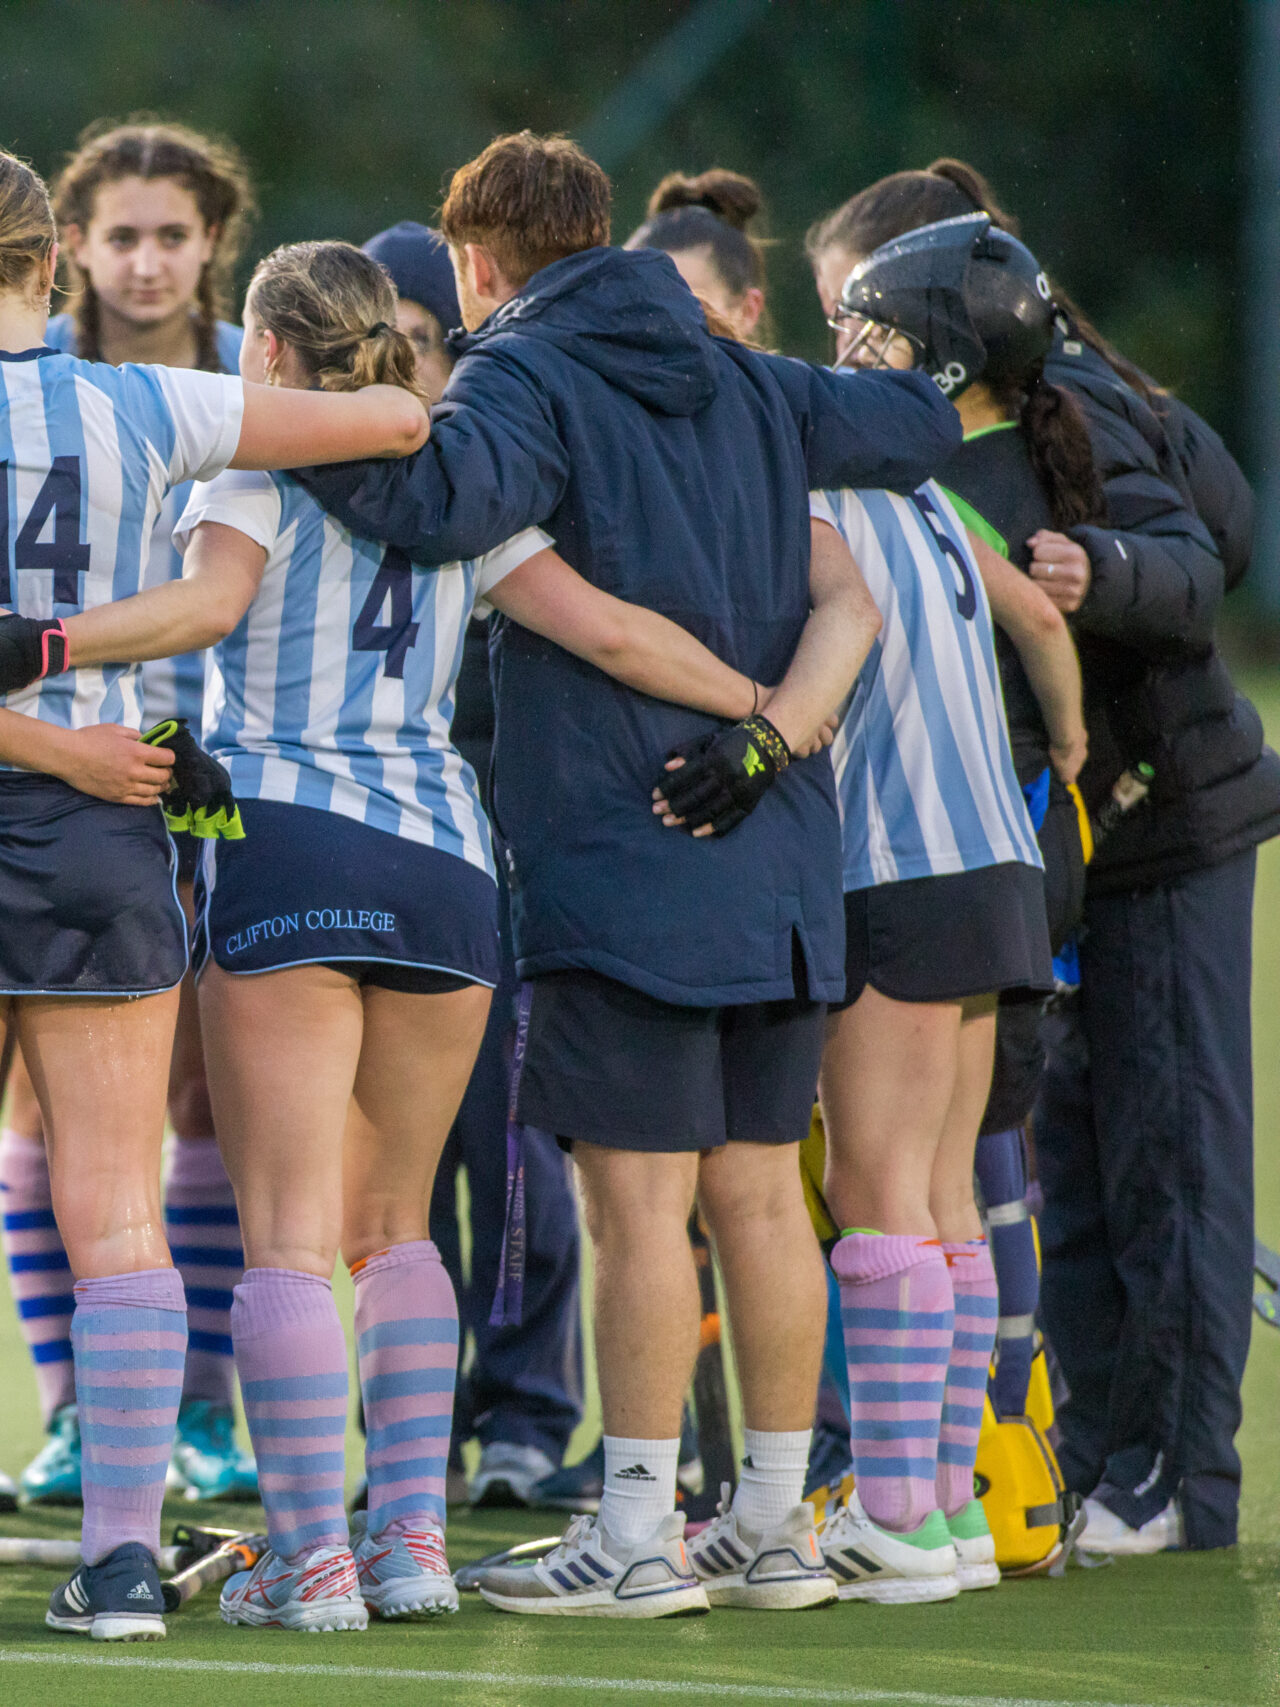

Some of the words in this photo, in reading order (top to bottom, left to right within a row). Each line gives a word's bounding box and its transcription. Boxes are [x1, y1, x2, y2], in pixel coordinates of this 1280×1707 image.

[932, 361, 966, 395] BO
[910, 493, 977, 621] 5
[352, 544, 420, 679] 4
[226, 912, 300, 955] CLIFTON
[305, 908, 396, 932] COLLEGE
[126, 1591, 154, 1600] adidas
